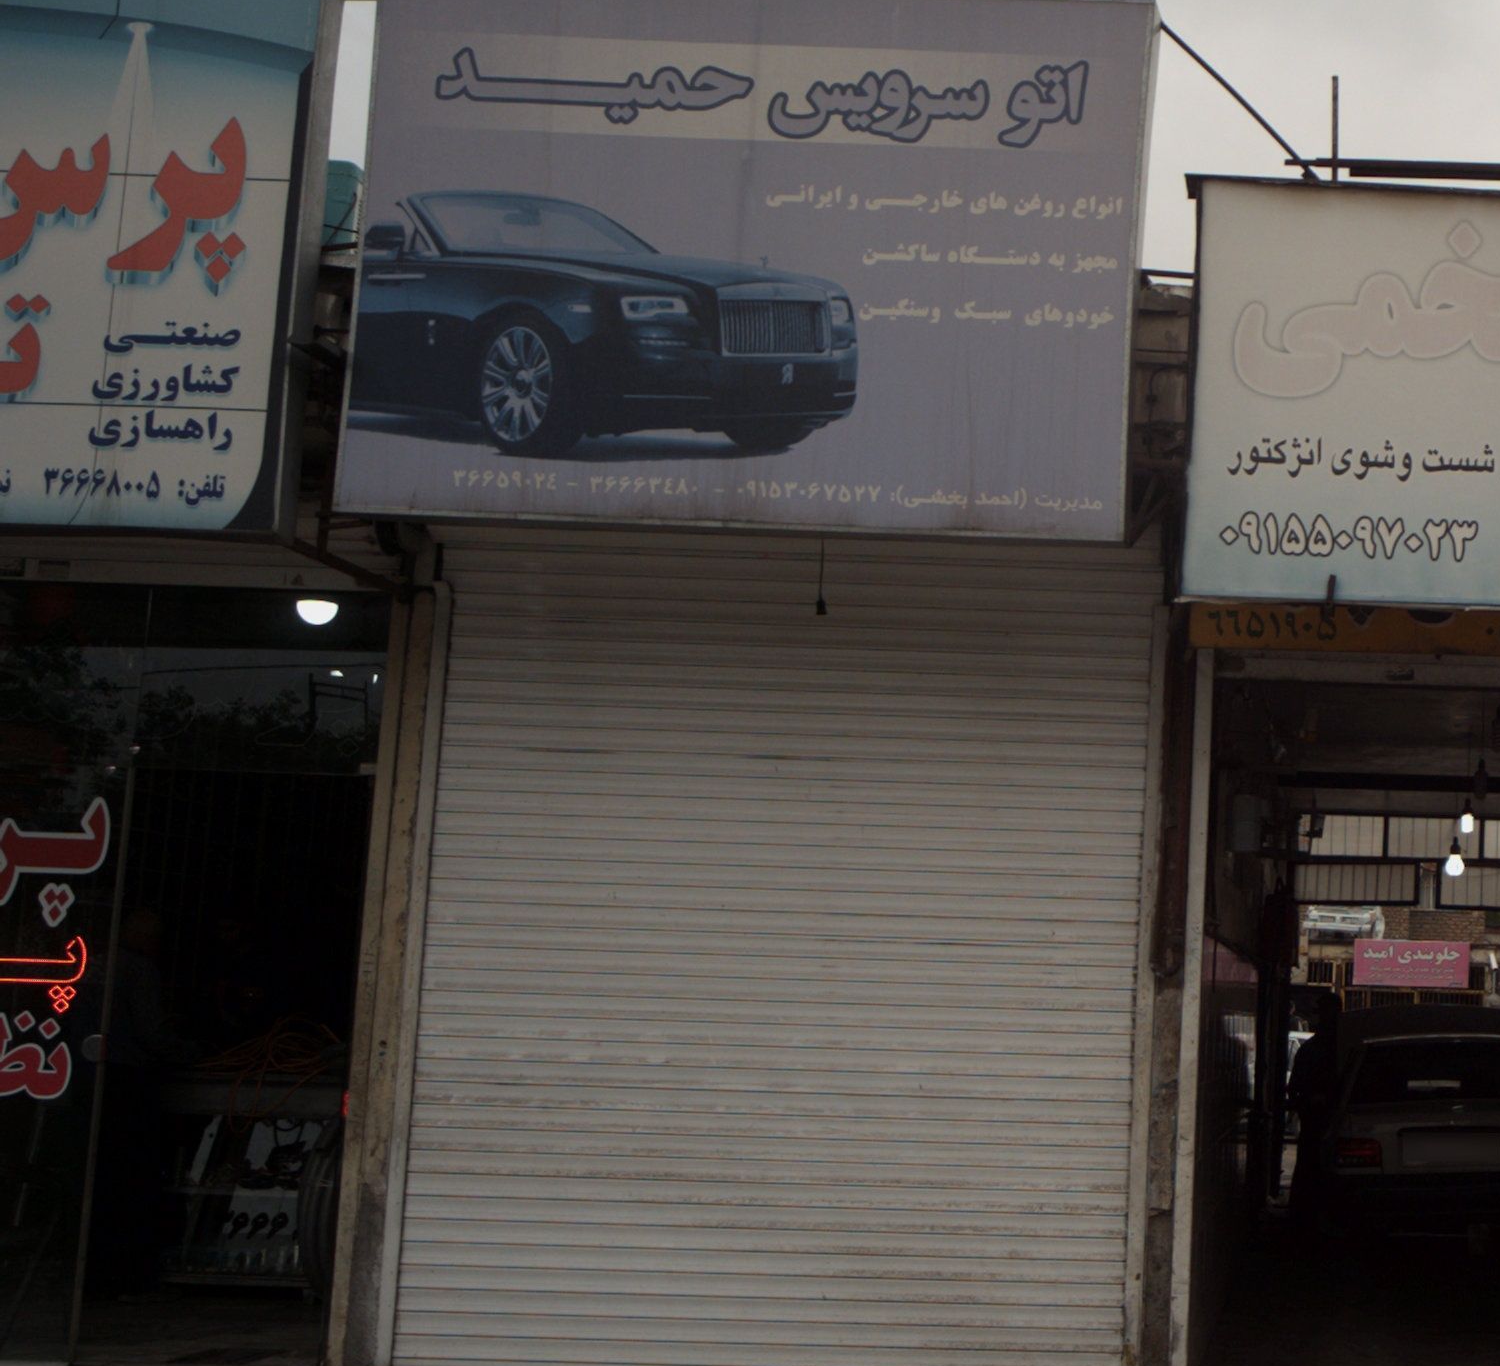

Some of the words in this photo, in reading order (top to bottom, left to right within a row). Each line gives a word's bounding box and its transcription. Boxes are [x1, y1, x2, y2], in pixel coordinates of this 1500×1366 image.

[436, 47, 754, 124] حمید
[769, 69, 990, 142] سرویس
[1000, 60, 1090, 147] اتو
[766, 184, 842, 209] ایرانی
[847, 193, 858, 211] و
[865, 188, 964, 214] خارجی
[970, 190, 1008, 216] های
[1014, 193, 1064, 219] روغن
[1072, 194, 1123, 219] انواع
[862, 242, 941, 266] ساکشن
[946, 244, 1042, 267] دستگاه
[1047, 252, 1066, 272] به
[1071, 253, 1119, 274] مجهز
[953, 300, 1013, 325] سبک
[103, 322, 242, 355] صنعتی
[91, 363, 240, 402] کشاورزی
[87, 410, 233, 452] راهسازی
[1225, 436, 1322, 478] انژکتور
[1421, 444, 1496, 473] شست
[43, 468, 161, 500] ۳۶۶۶۸۰۰۵
[1034, 491, 1103, 512] مدیریت
[1219, 511, 1479, 562] ۰۹۱۵۵۰۹۷۰۲۳
[1363, 944, 1394, 962] امید
